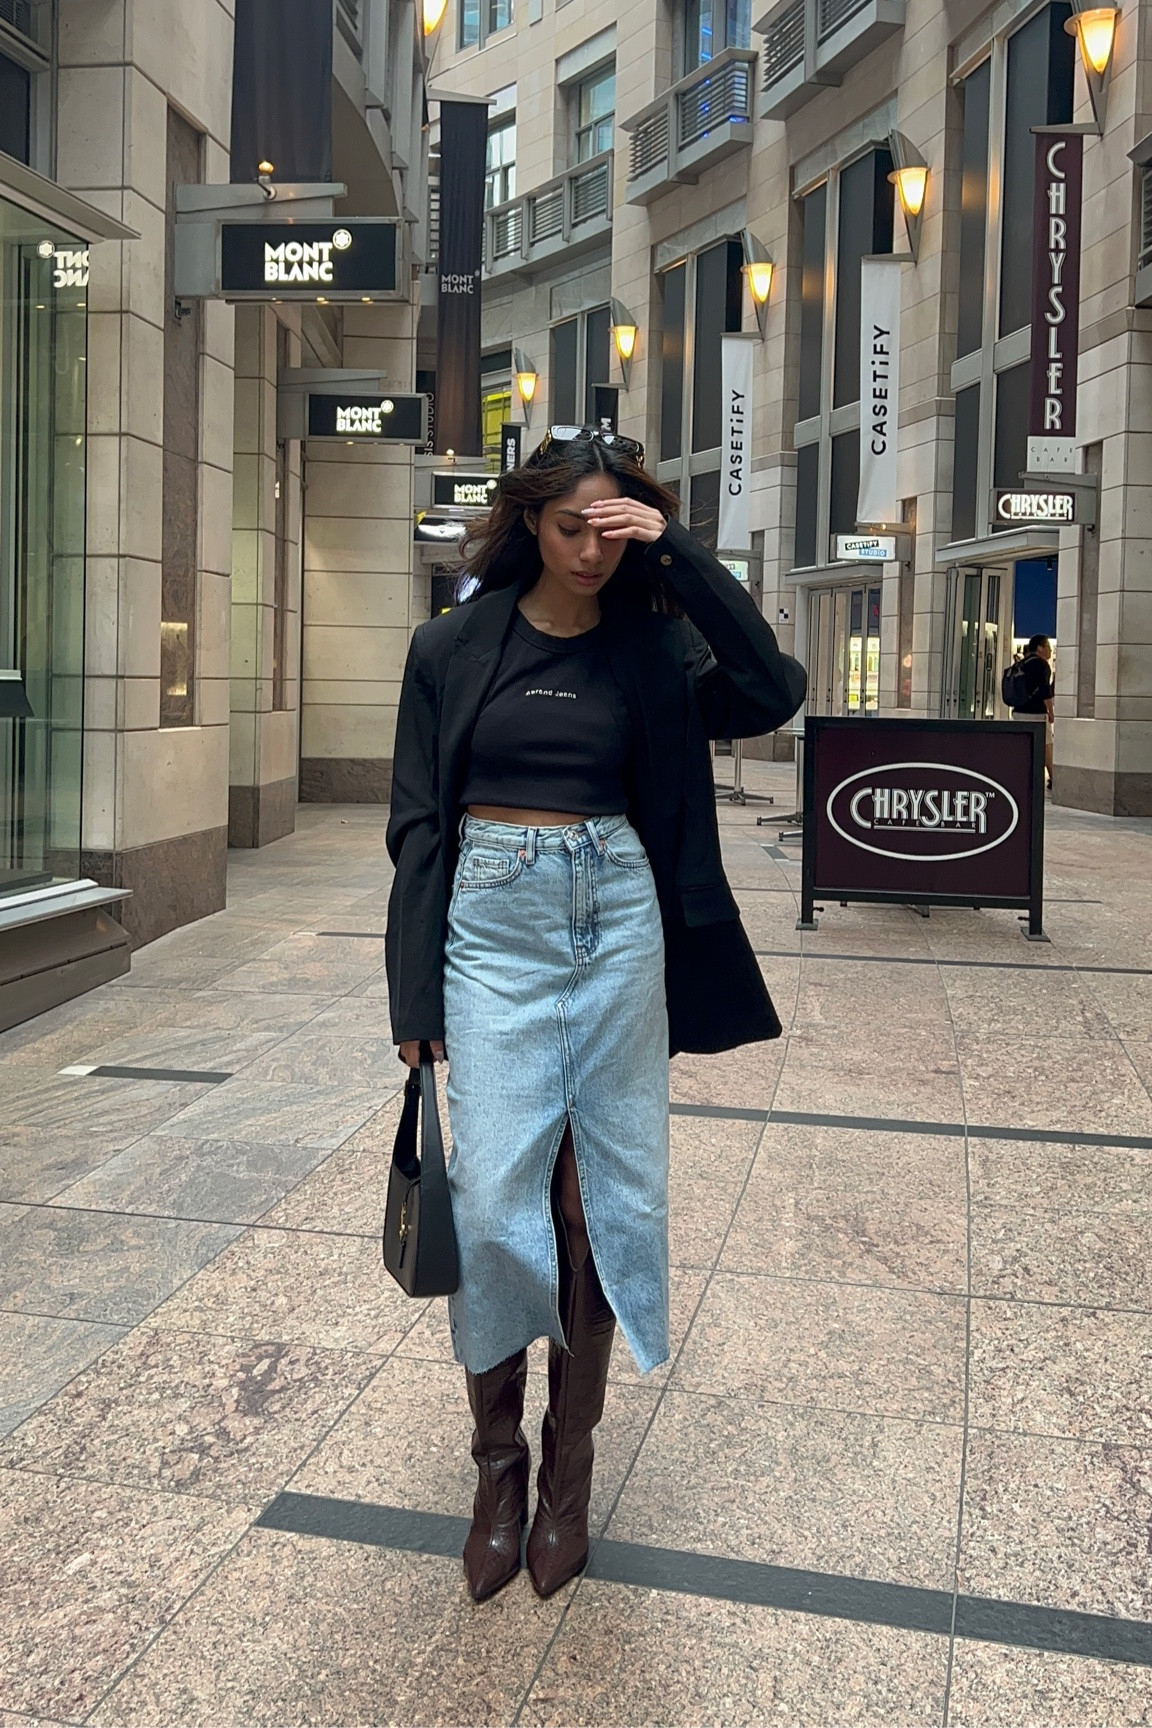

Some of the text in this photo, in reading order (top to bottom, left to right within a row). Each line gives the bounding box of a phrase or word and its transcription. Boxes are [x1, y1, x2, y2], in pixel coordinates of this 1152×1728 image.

[264, 241, 333, 262] MONT
[264, 261, 333, 281] BLANC
[441, 274, 474, 284] MONT
[1044, 141, 1067, 430] CHRYSLER
[441, 283, 474, 294] BLANC
[336, 406, 382, 420] MONT
[336, 418, 382, 432] BLANC
[454, 483, 488, 495] MONT
[454, 493, 488, 504] BLANC
[998, 493, 1073, 520] CHRYSLER
[873, 819, 977, 829] CAFE BAR
